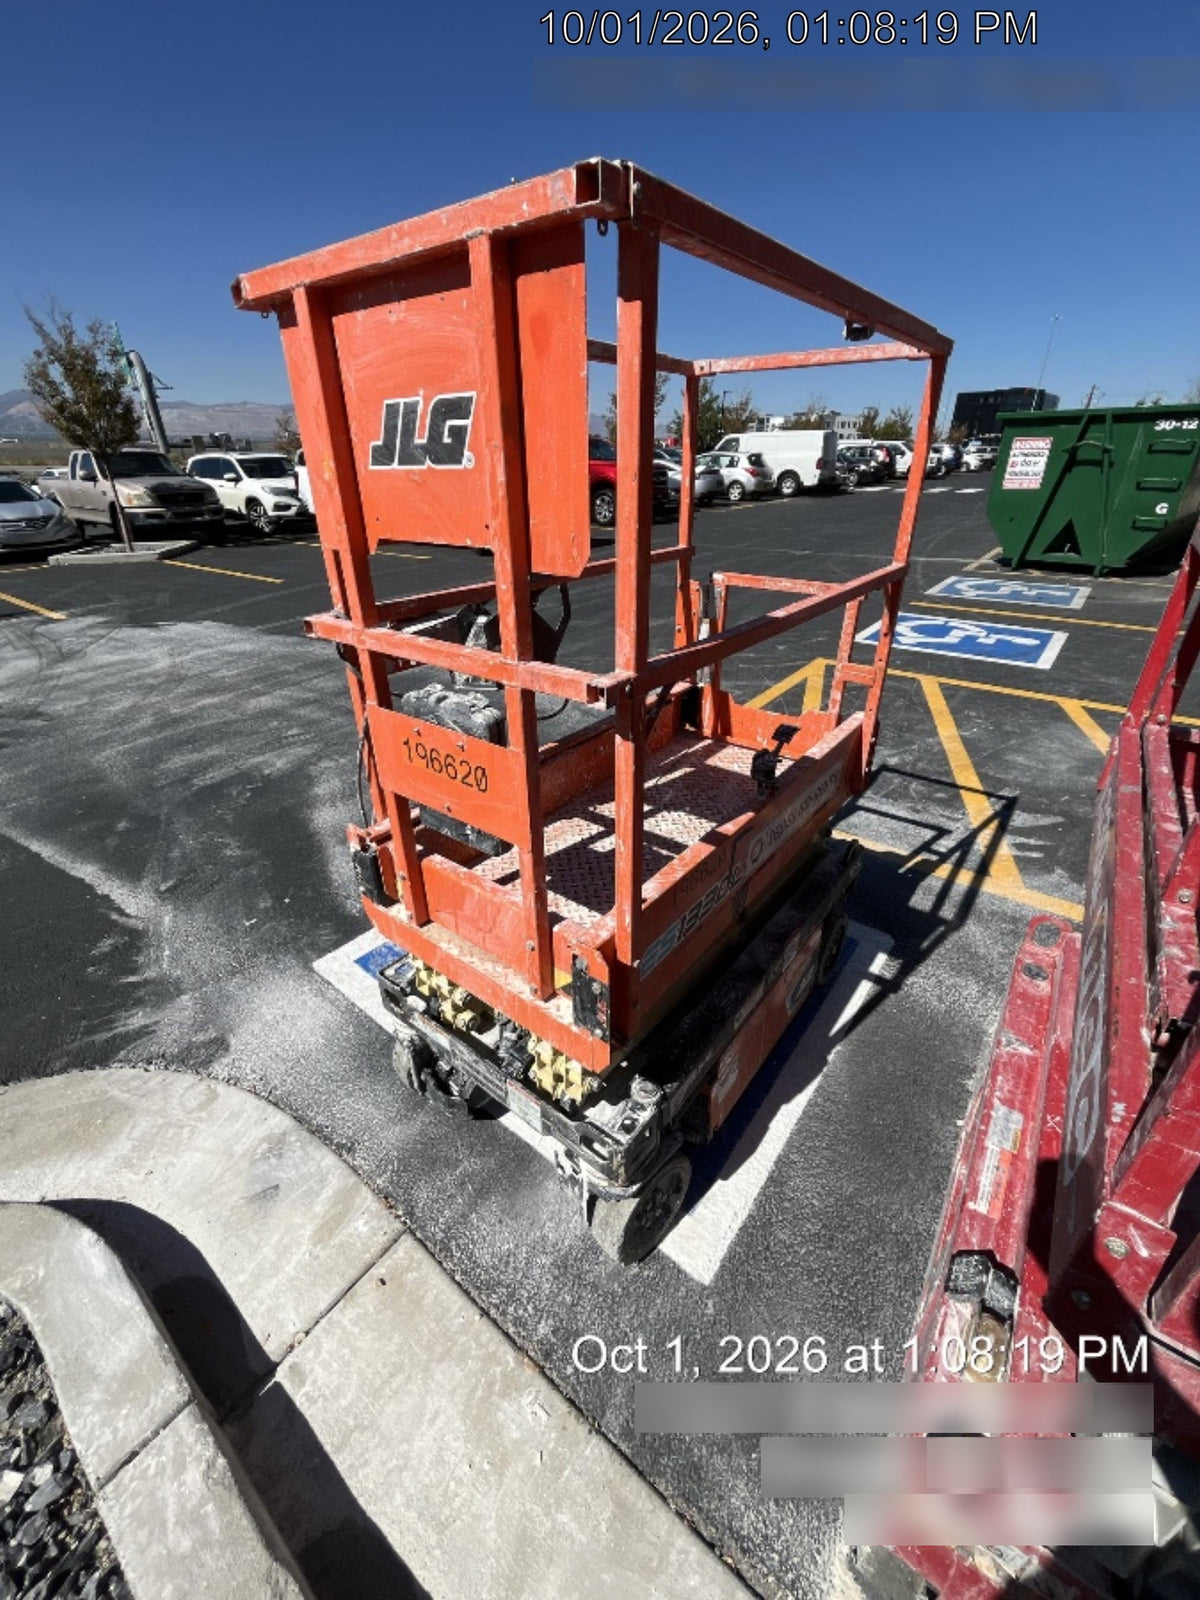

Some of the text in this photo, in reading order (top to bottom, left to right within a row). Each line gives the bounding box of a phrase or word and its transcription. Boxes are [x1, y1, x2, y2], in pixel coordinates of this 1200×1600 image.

[369, 391, 476, 469] JLG
[1155, 503, 1169, 514] G
[403, 737, 488, 793] 196620
